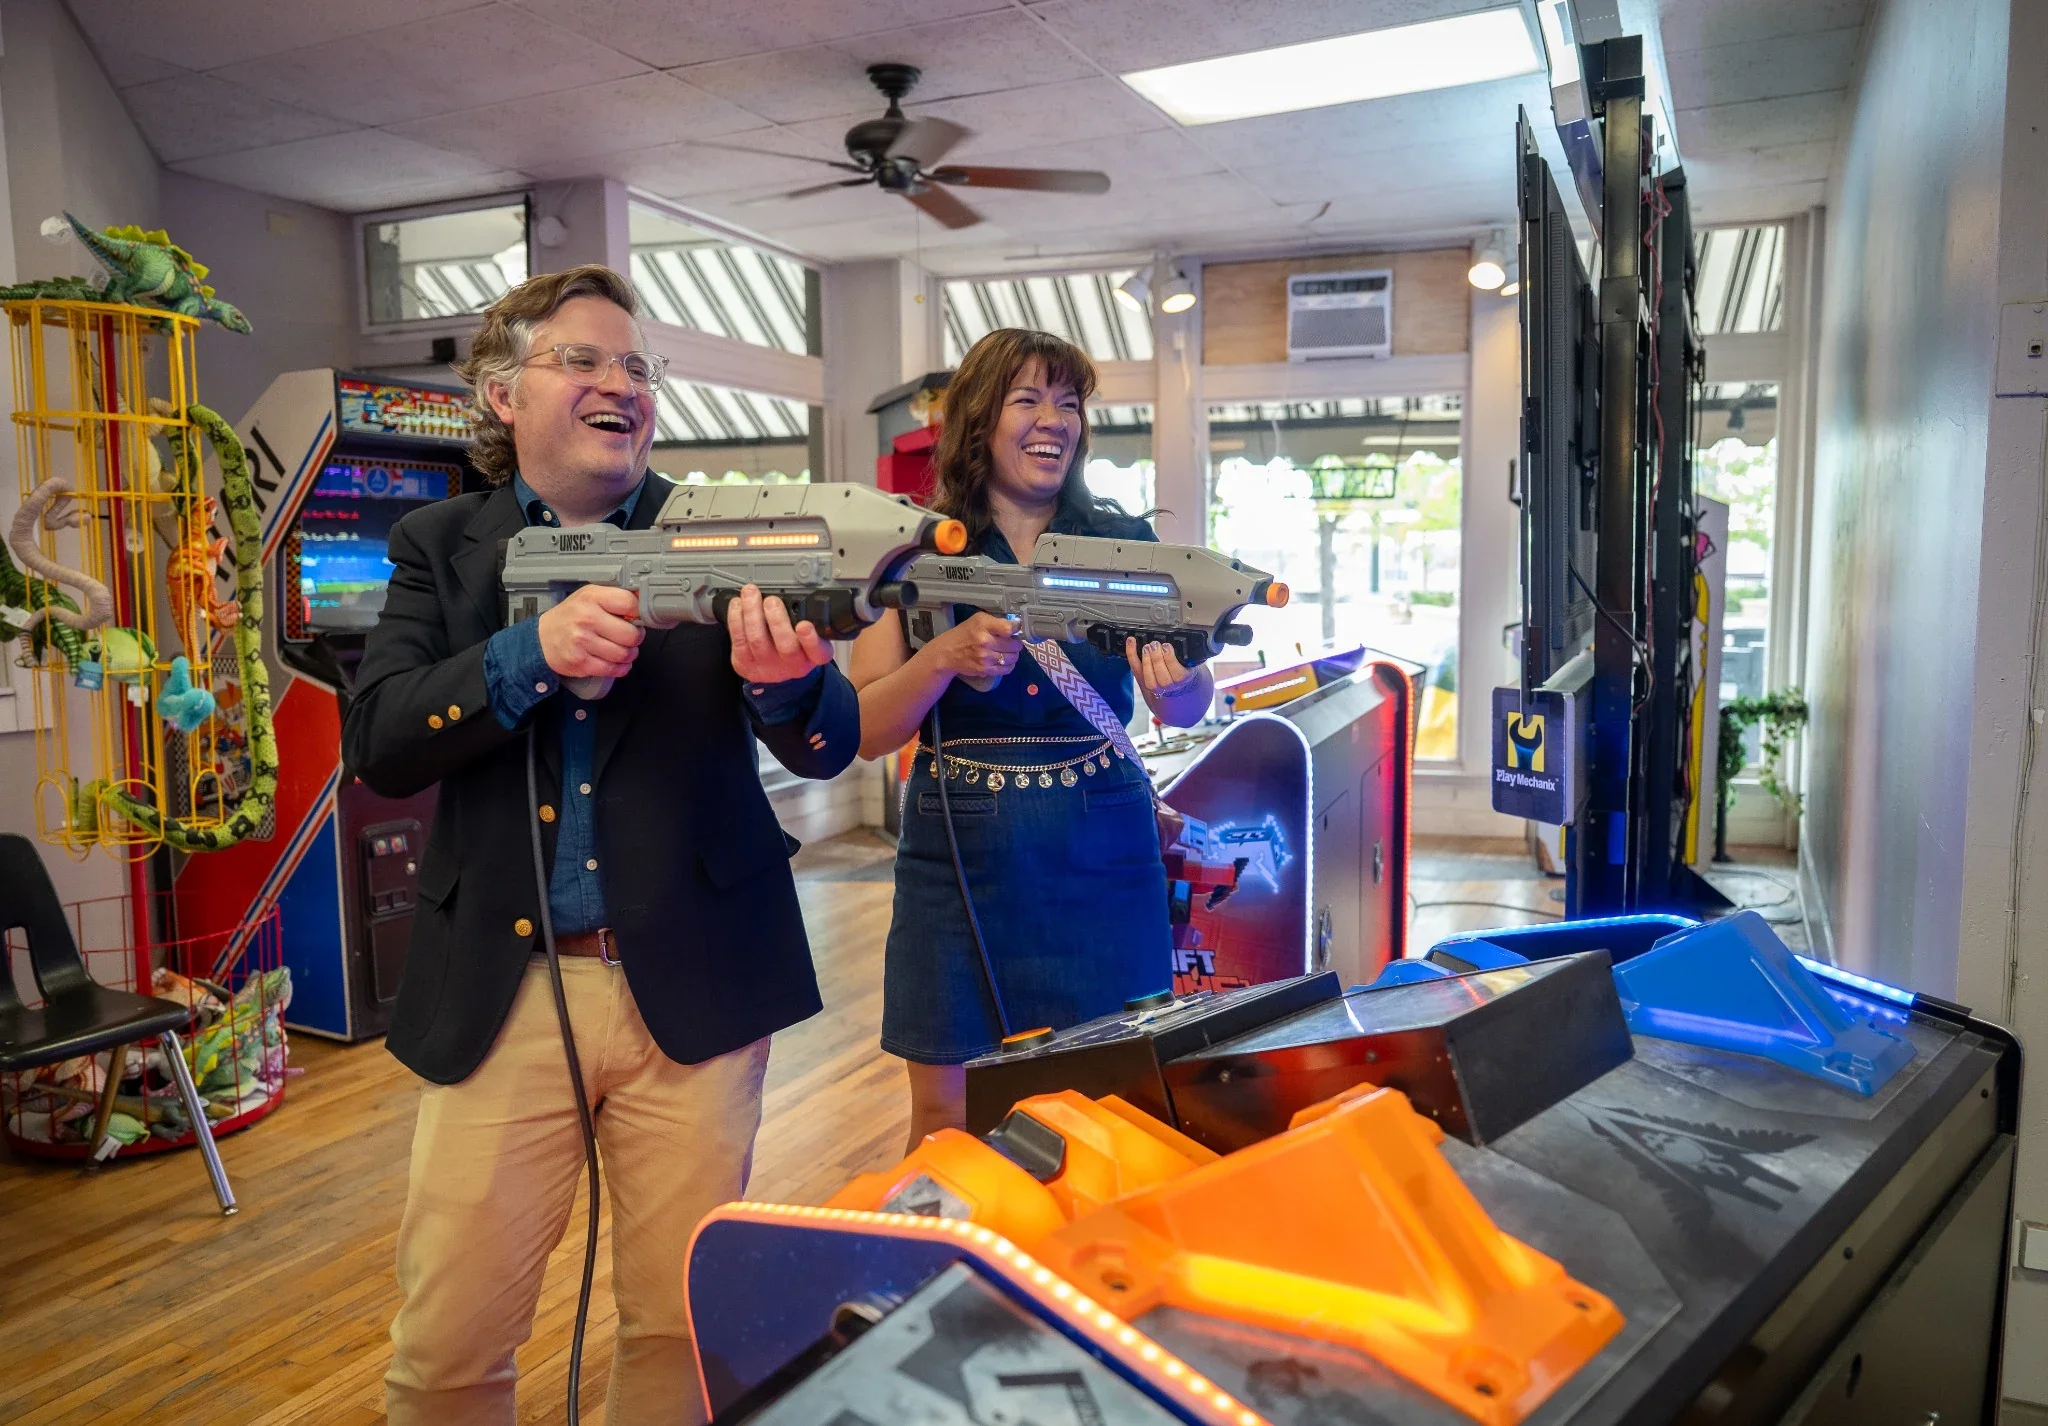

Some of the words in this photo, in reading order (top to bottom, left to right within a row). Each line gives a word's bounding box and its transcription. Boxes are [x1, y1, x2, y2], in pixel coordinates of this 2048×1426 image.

[559, 534, 586, 551] UNSC
[945, 566, 969, 580] UNSC
[1496, 769, 1516, 787] Play
[1516, 773, 1555, 791] Mechanix
